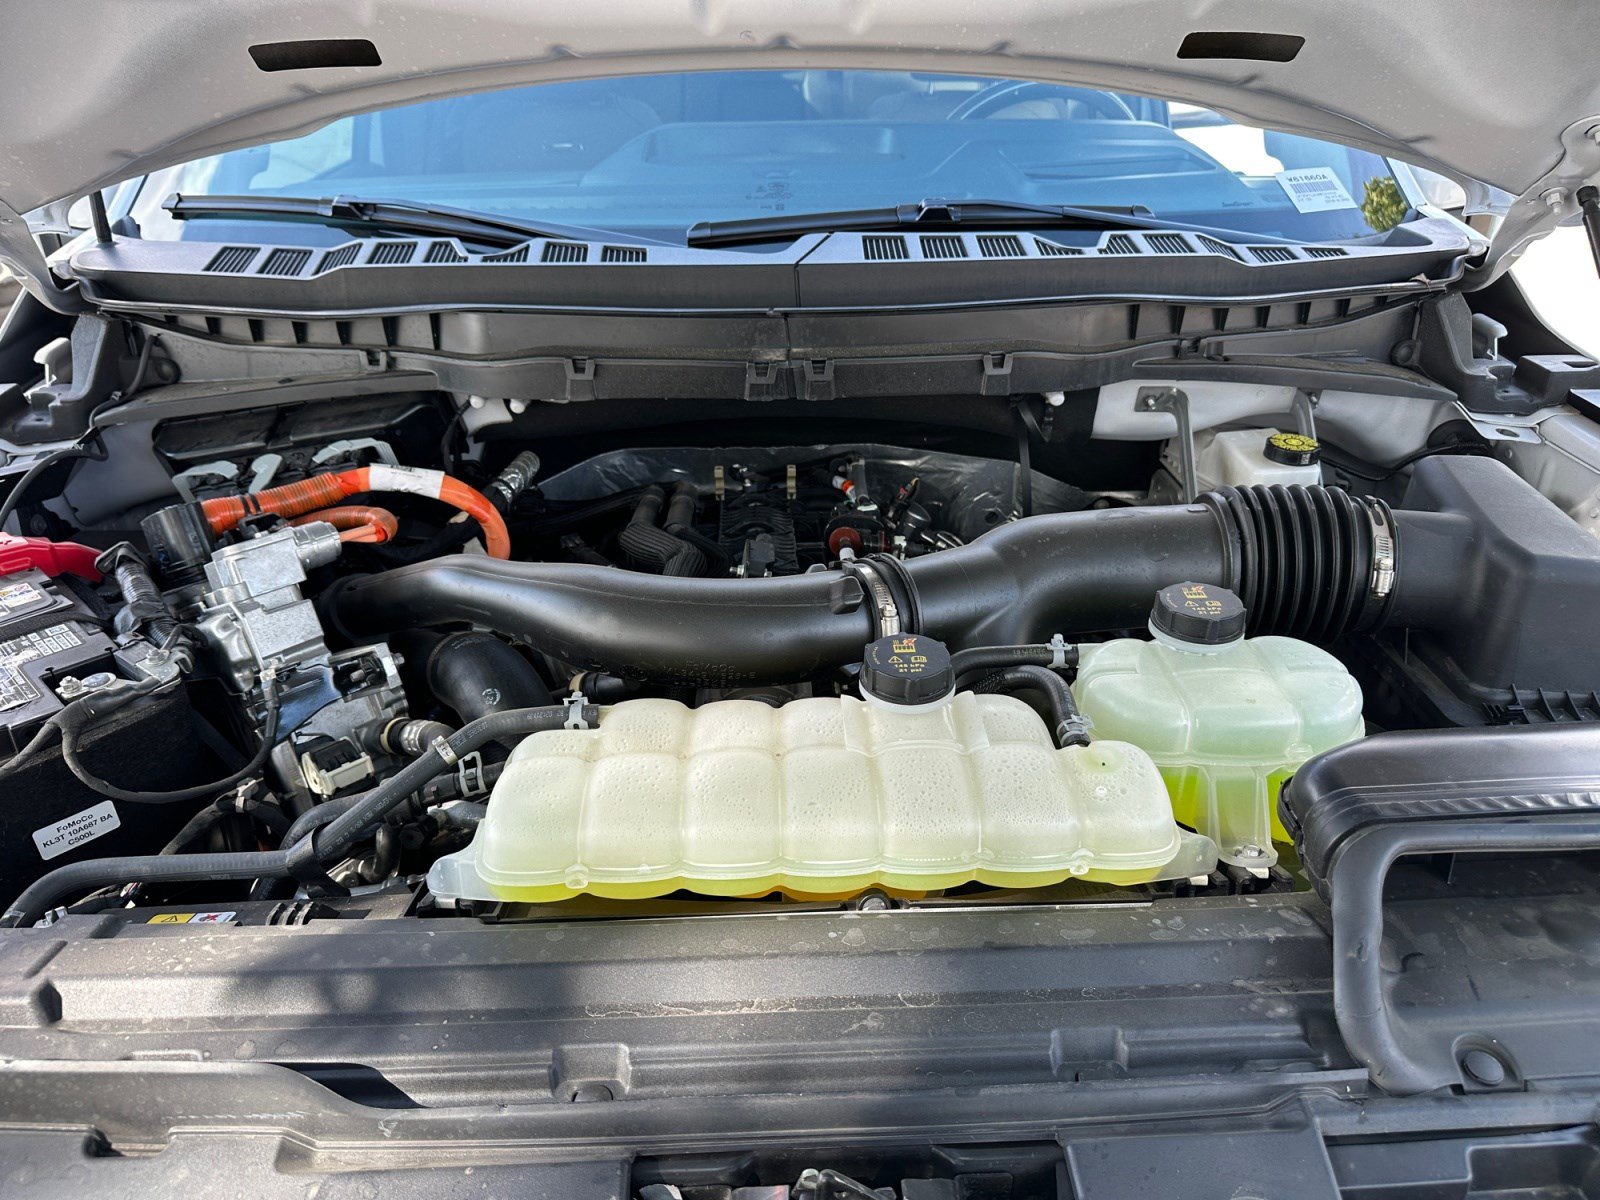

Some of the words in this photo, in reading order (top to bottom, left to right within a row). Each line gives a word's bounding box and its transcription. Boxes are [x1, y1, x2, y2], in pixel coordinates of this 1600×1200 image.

[42, 834, 66, 848] KL3T
[68, 819, 98, 837] 10A687
[99, 813, 113, 823] BA
[56, 813, 94, 833] FoMoCo
[67, 830, 95, 845] C500L
